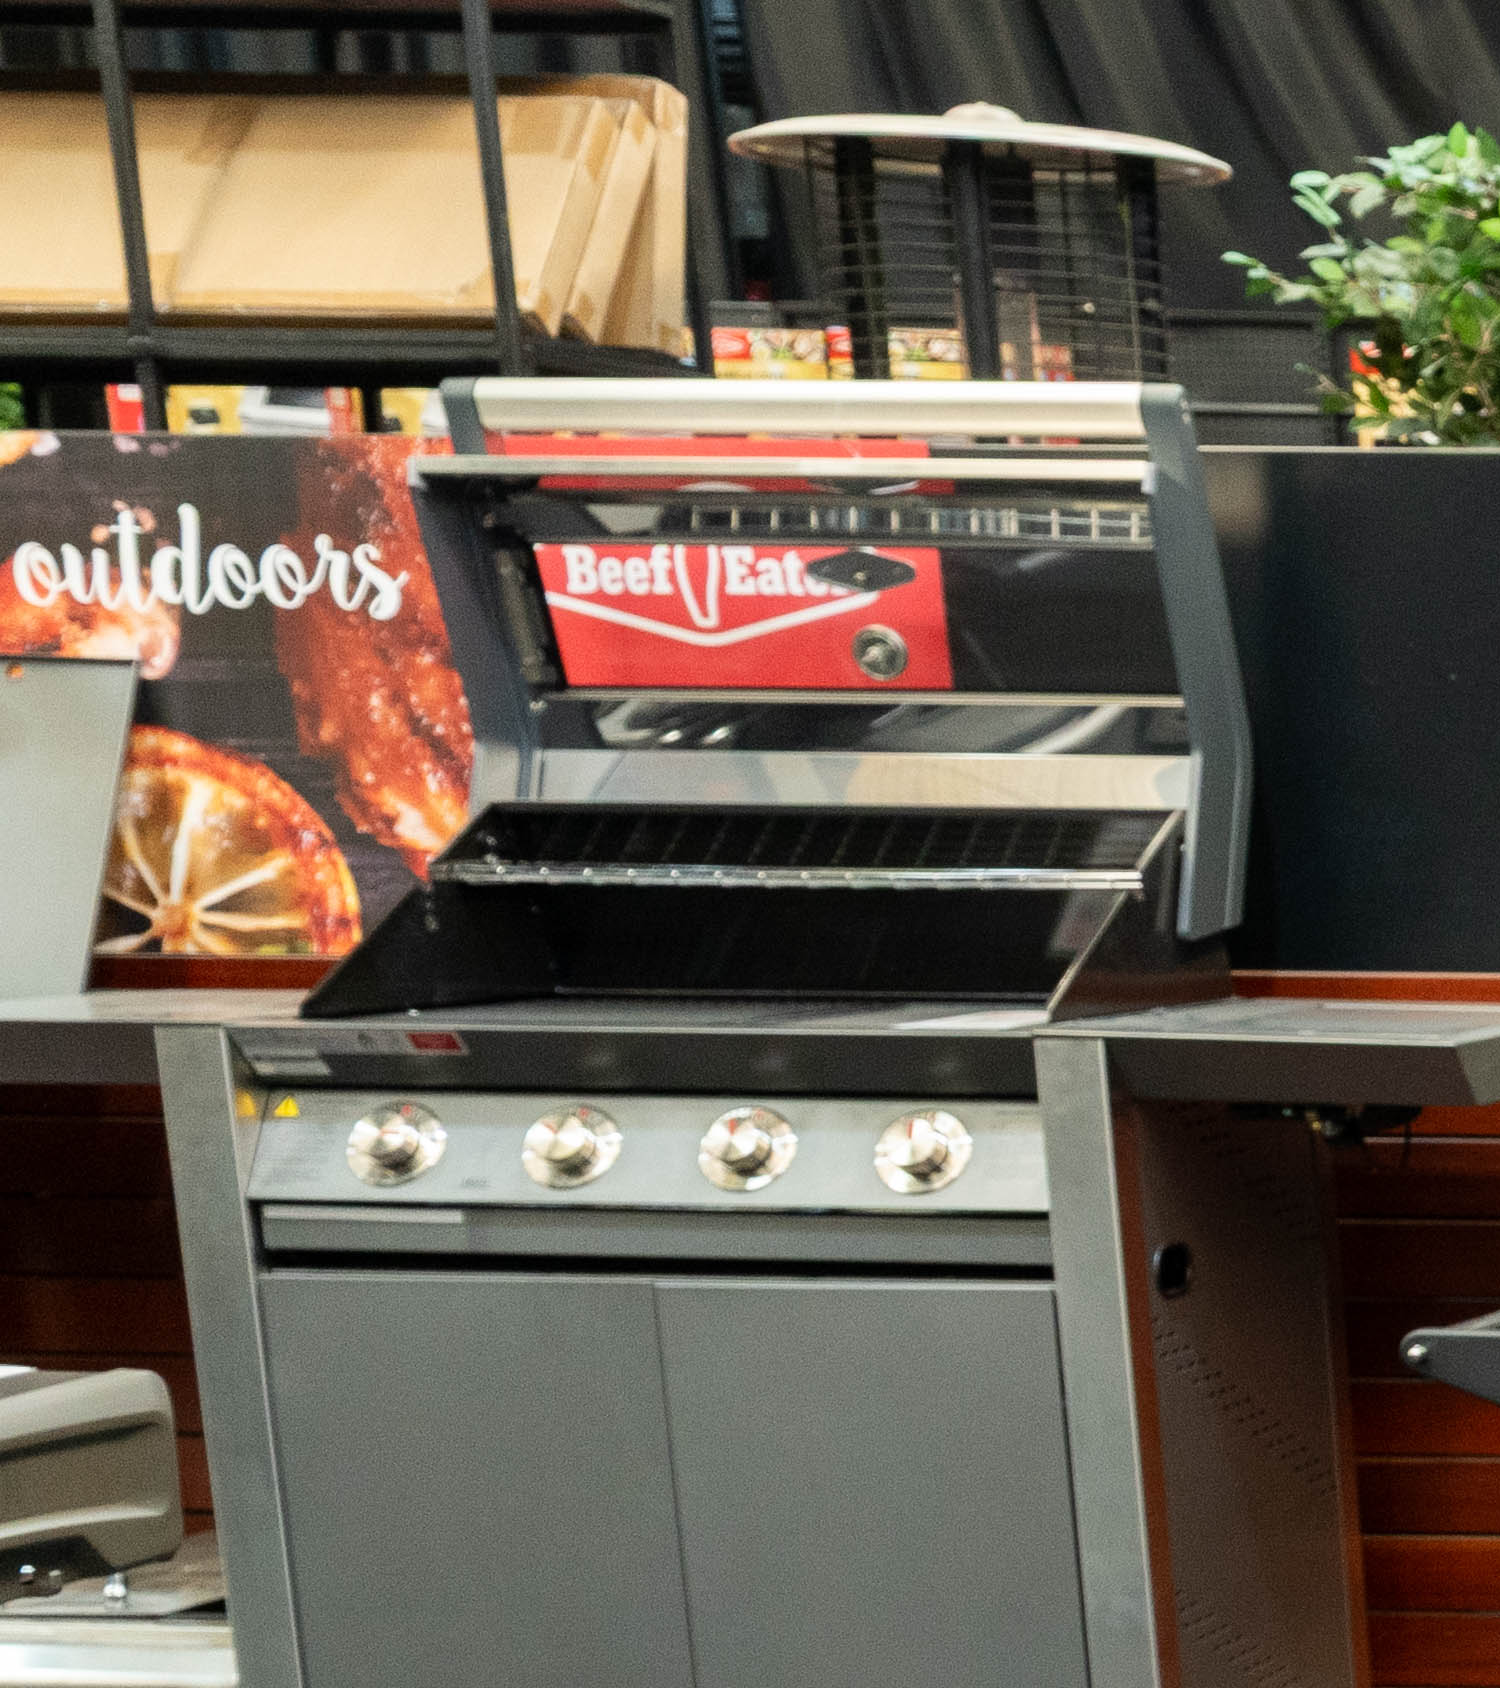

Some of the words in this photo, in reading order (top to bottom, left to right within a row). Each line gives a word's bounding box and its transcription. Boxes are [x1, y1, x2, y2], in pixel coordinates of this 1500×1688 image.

[12, 501, 410, 621] outdoors
[562, 545, 673, 595] Beef
[720, 545, 868, 597] Eat
